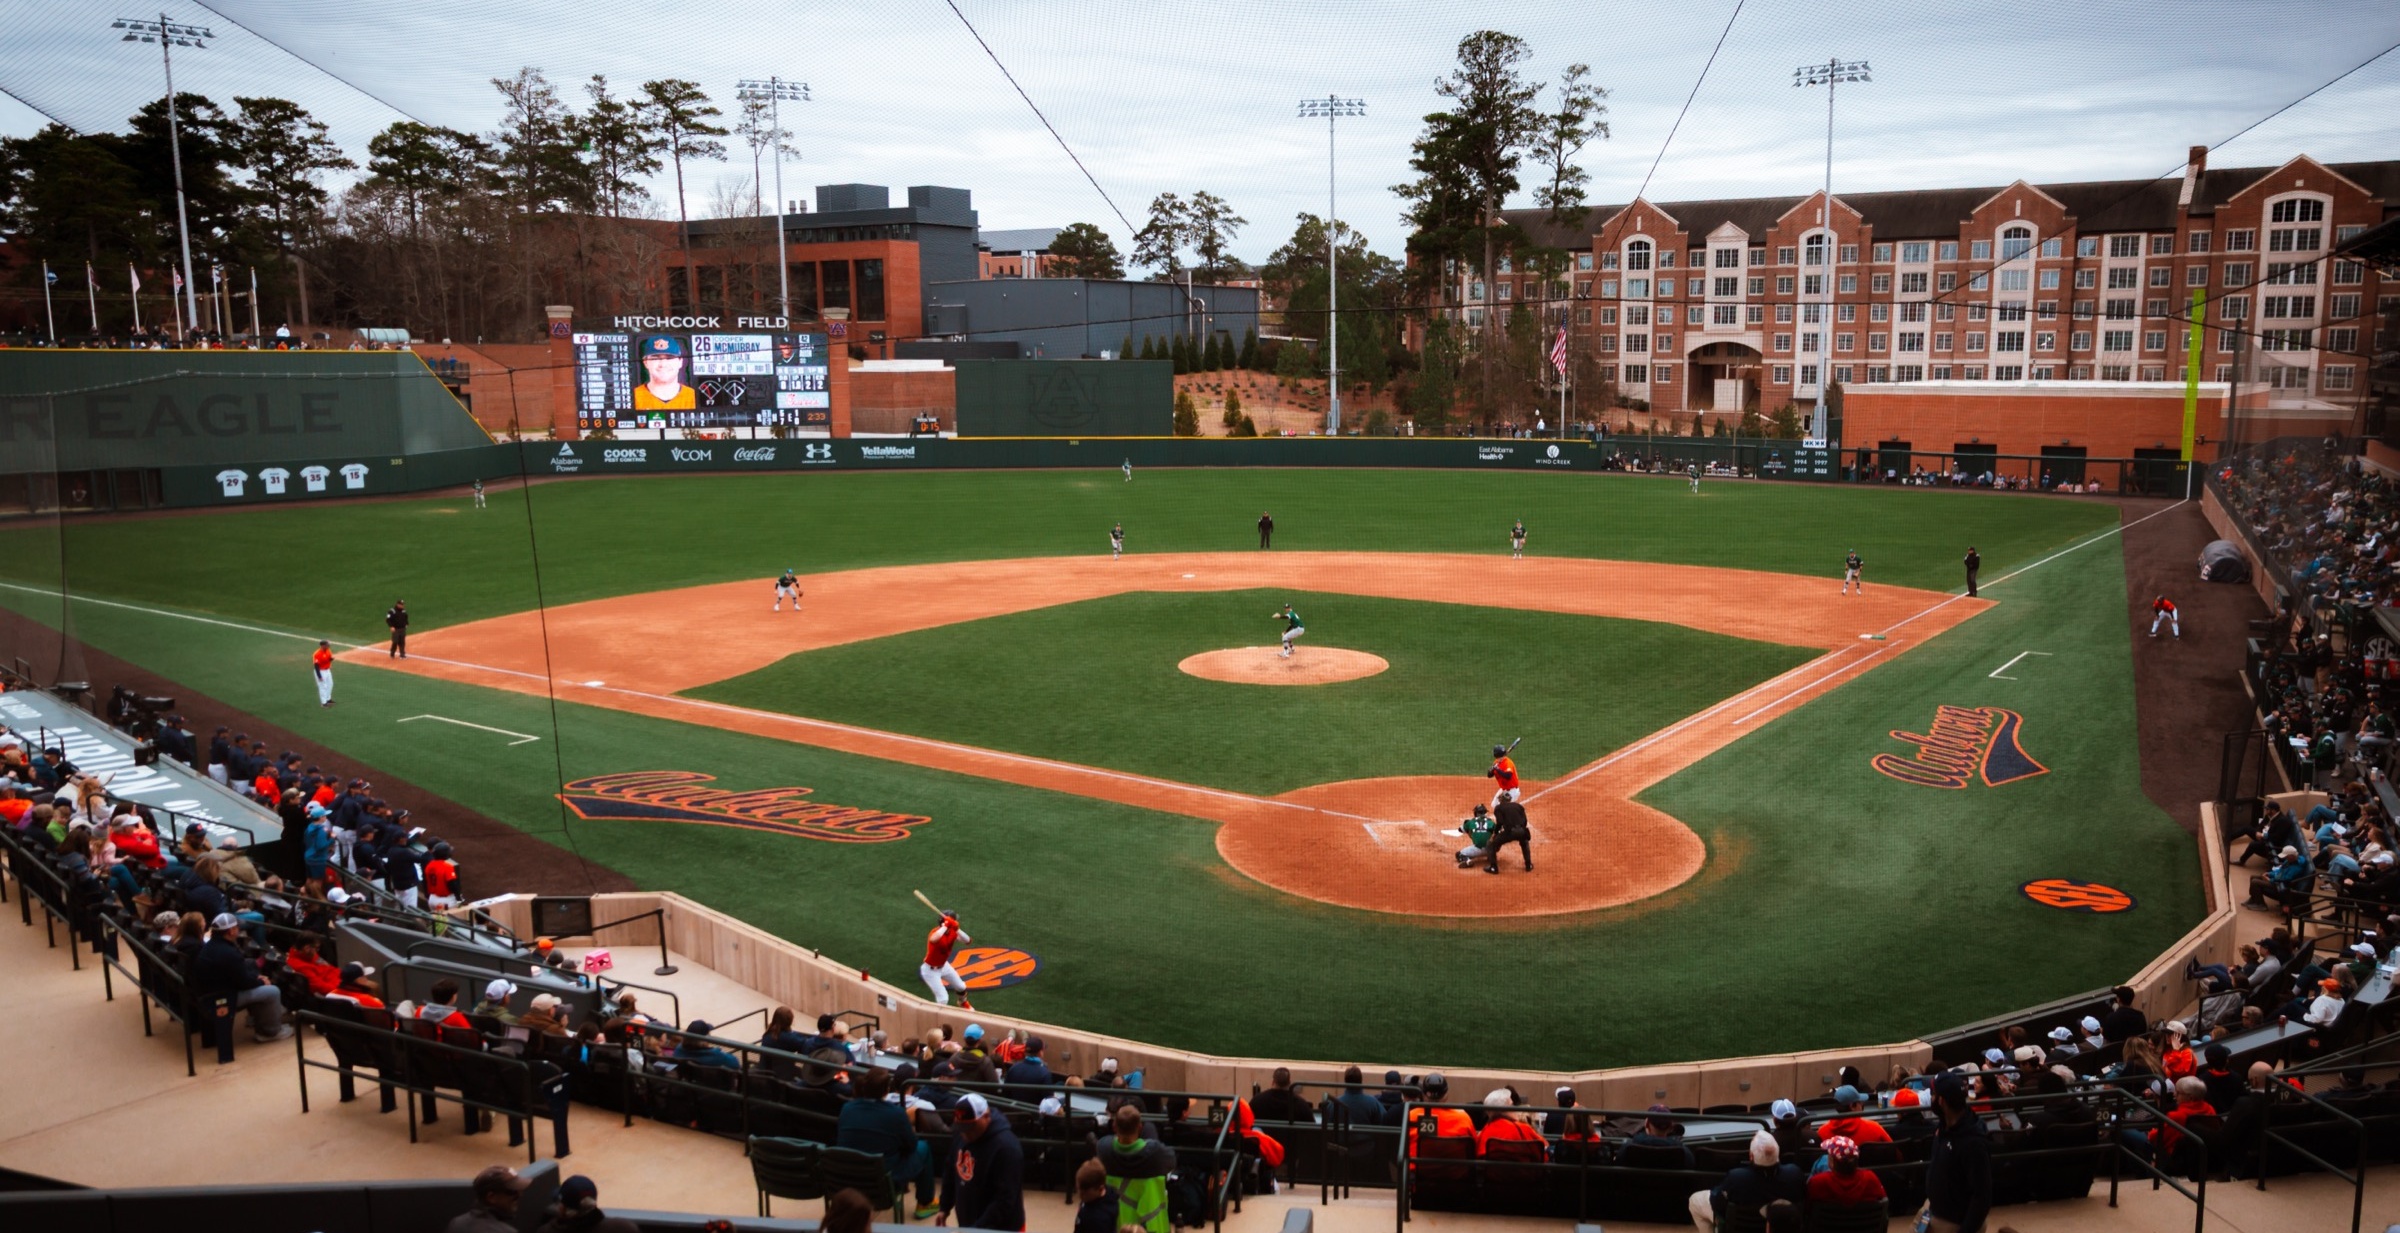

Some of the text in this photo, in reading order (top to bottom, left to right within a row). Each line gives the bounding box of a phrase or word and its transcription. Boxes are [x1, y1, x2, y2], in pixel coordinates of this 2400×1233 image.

[614, 316, 788, 328] HITCHCOCK FIELD
[694, 336, 711, 352] 26
[84, 392, 343, 439] EAGLE
[604, 449, 646, 458] COOK'S
[671, 447, 712, 462] VCOM
[861, 446, 915, 455] YellaWood
[310, 474, 321, 482] 35
[1212, 1112, 1224, 1122] 21
[1420, 1122, 1435, 1132] 20
